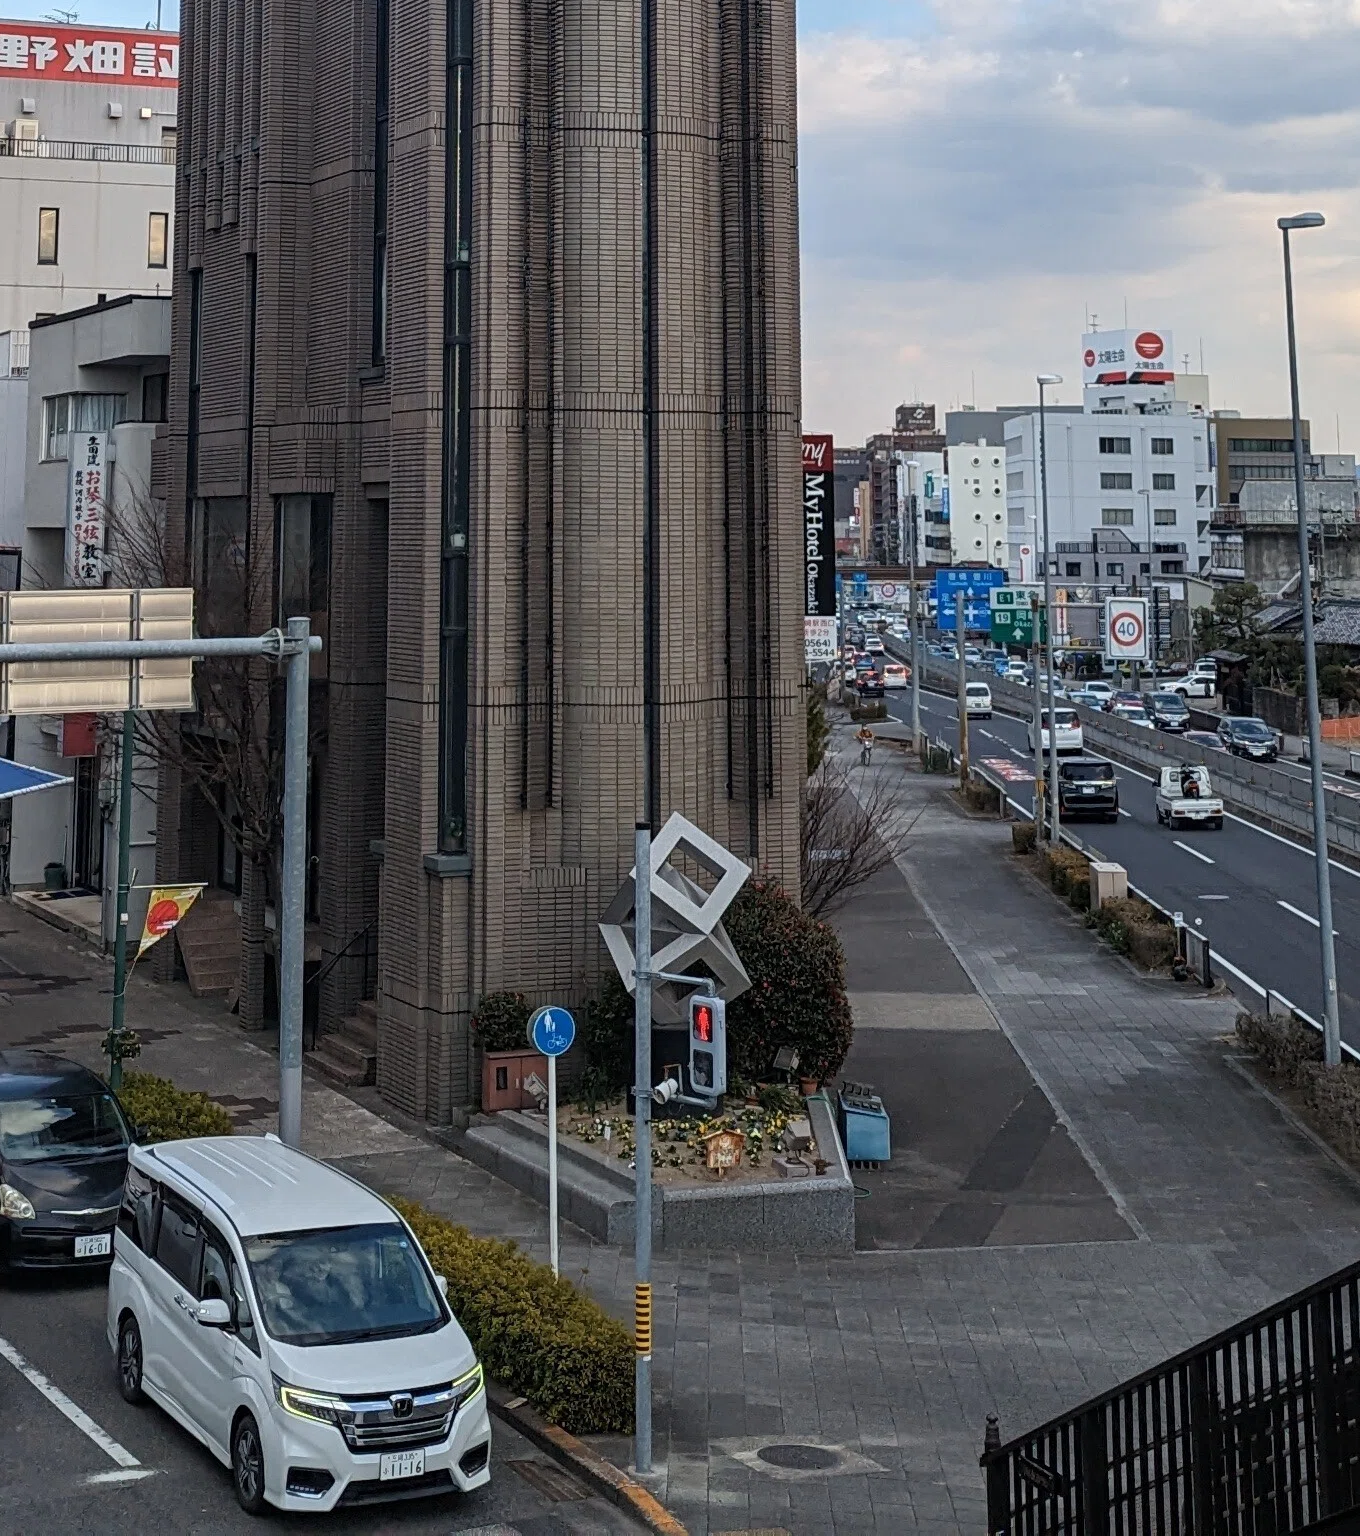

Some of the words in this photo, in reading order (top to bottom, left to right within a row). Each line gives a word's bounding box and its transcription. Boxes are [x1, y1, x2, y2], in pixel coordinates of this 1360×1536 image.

[1098, 349, 1125, 364] 太陽生命
[1135, 362, 1164, 370] 太陽生命
[807, 563, 819, 614] Okazaki
[998, 614, 1009, 623] 19
[1118, 622, 1136, 637] 40
[83, 1242, 108, 1255] 16-01
[392, 1460, 422, 1477] 11-16
